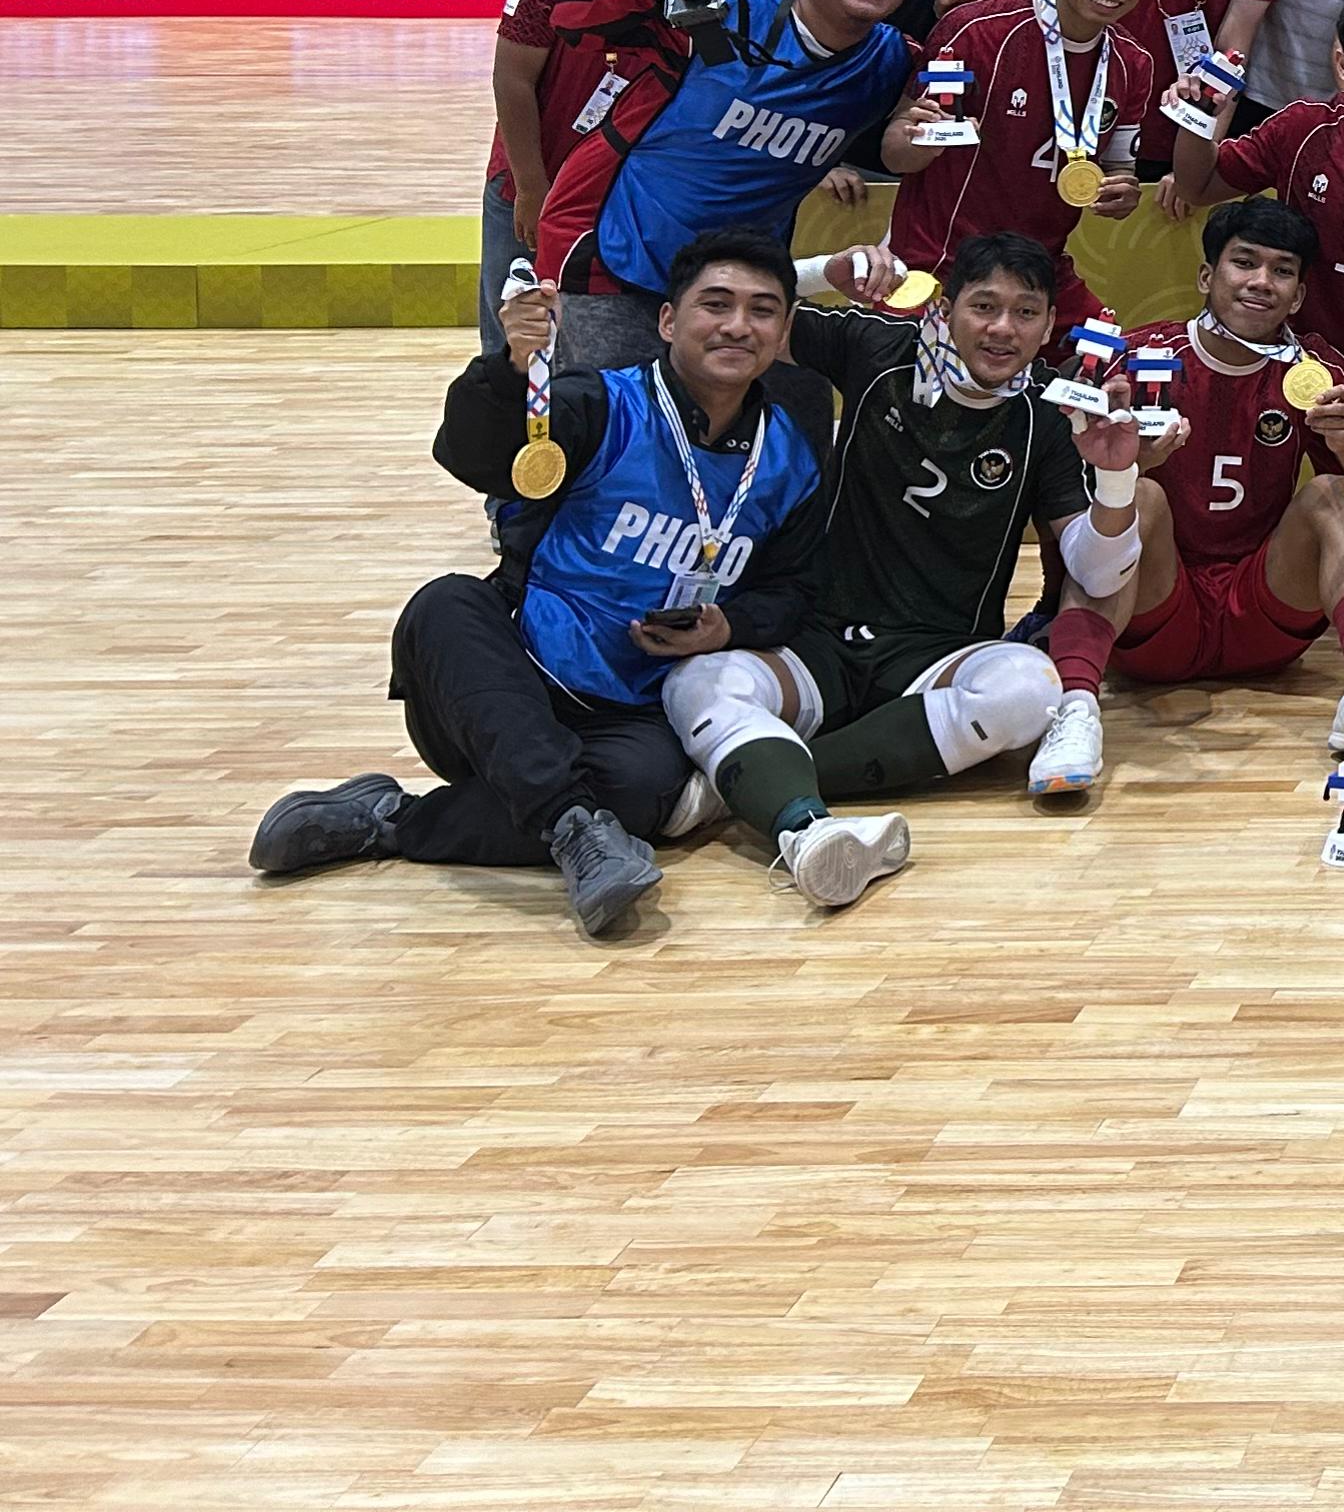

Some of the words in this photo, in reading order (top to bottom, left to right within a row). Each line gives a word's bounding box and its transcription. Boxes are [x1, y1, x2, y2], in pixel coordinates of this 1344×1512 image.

[713, 98, 846, 167] PHOTO
[1031, 136, 1060, 183] 4
[903, 457, 947, 518] 2
[1208, 456, 1244, 511] 5
[602, 502, 753, 586] PHOO
